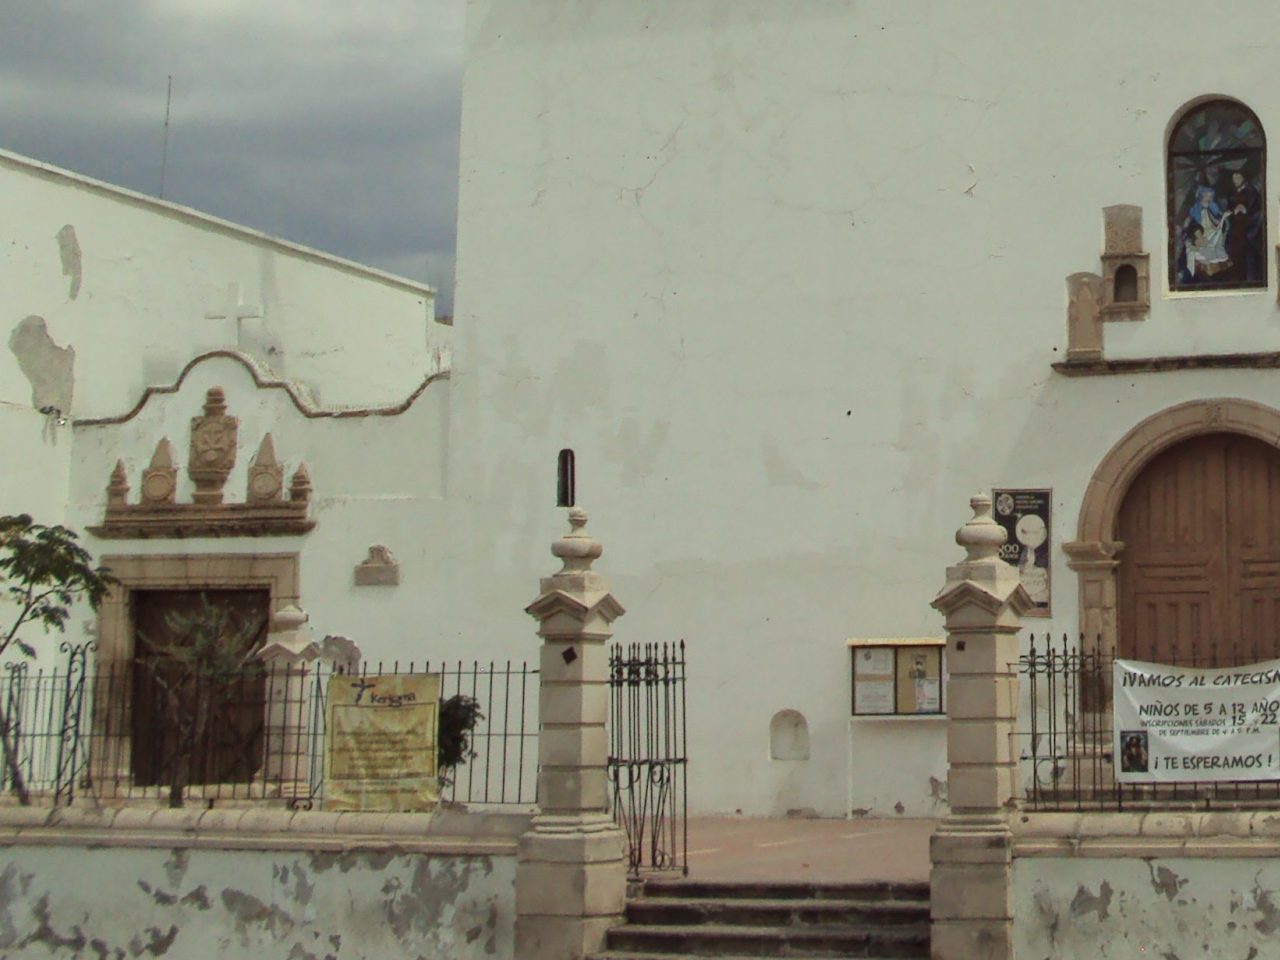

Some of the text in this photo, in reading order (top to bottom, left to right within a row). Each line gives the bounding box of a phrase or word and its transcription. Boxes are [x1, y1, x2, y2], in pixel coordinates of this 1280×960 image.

[1122, 672, 1184, 687] ¡VAMOS
[1189, 676, 1206, 686] AL
[1139, 700, 1180, 716] NIÑOS
[1184, 704, 1199, 716] DE
[1203, 702, 1213, 715] 5
[1219, 703, 1227, 715] A
[1231, 702, 1246, 714] 12
[1231, 714, 1246, 726] 15
[1260, 713, 1277, 725] 22
[1164, 756, 1179, 769] TE
[1182, 753, 1263, 769] ESPERAMOS
